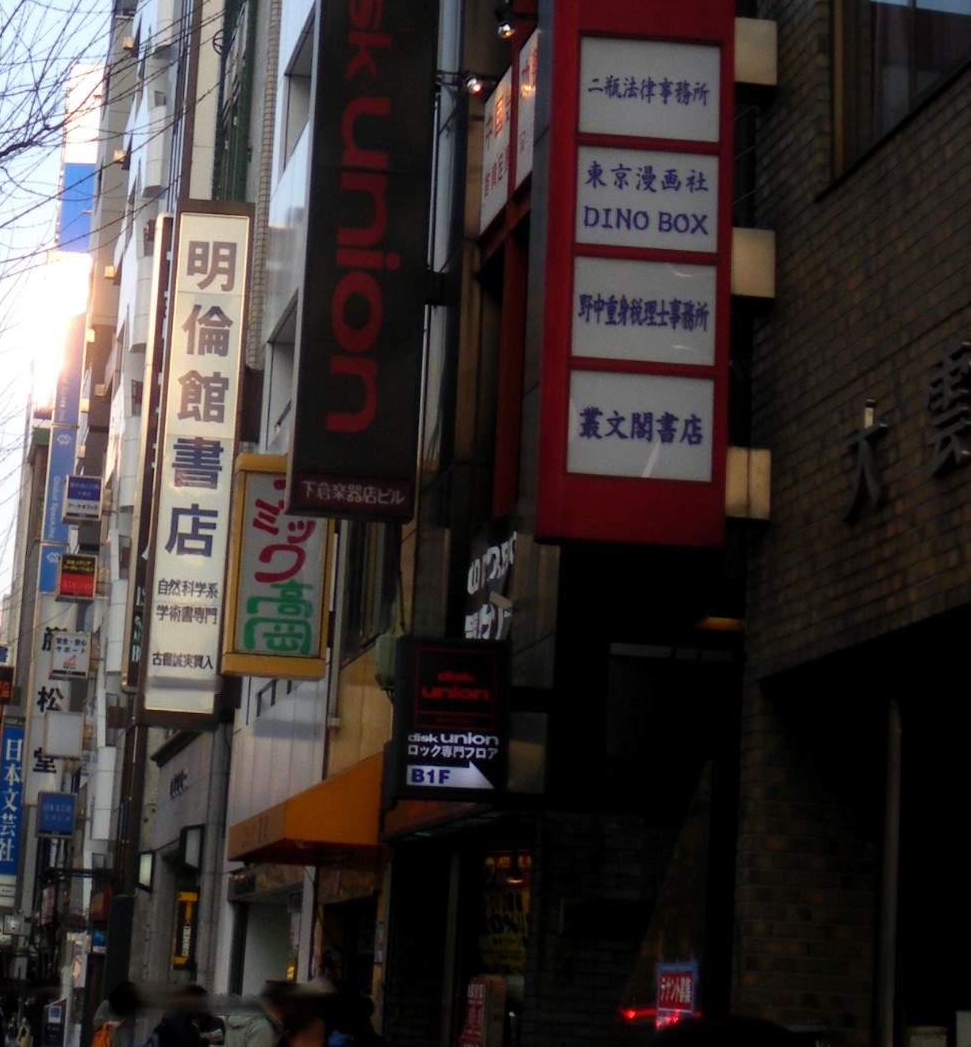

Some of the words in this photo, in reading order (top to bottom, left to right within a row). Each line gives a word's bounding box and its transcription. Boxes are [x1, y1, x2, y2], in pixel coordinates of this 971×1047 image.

[585, 160, 709, 194] 東京漫画社
[583, 205, 650, 231] DINO
[658, 212, 709, 235] BOX
[326, 96, 401, 434] union
[164, 240, 238, 558] 明倫館書店
[301, 478, 406, 507] 下倉楽器店ビル
[157, 578, 219, 599] 自然科学系
[156, 604, 218, 625] 学術書専門
[421, 684, 491, 701] union
[407, 732, 439, 744] disk
[440, 731, 500, 746] union
[407, 744, 499, 761] ロック専門フロア
[411, 767, 450, 784] B1F
